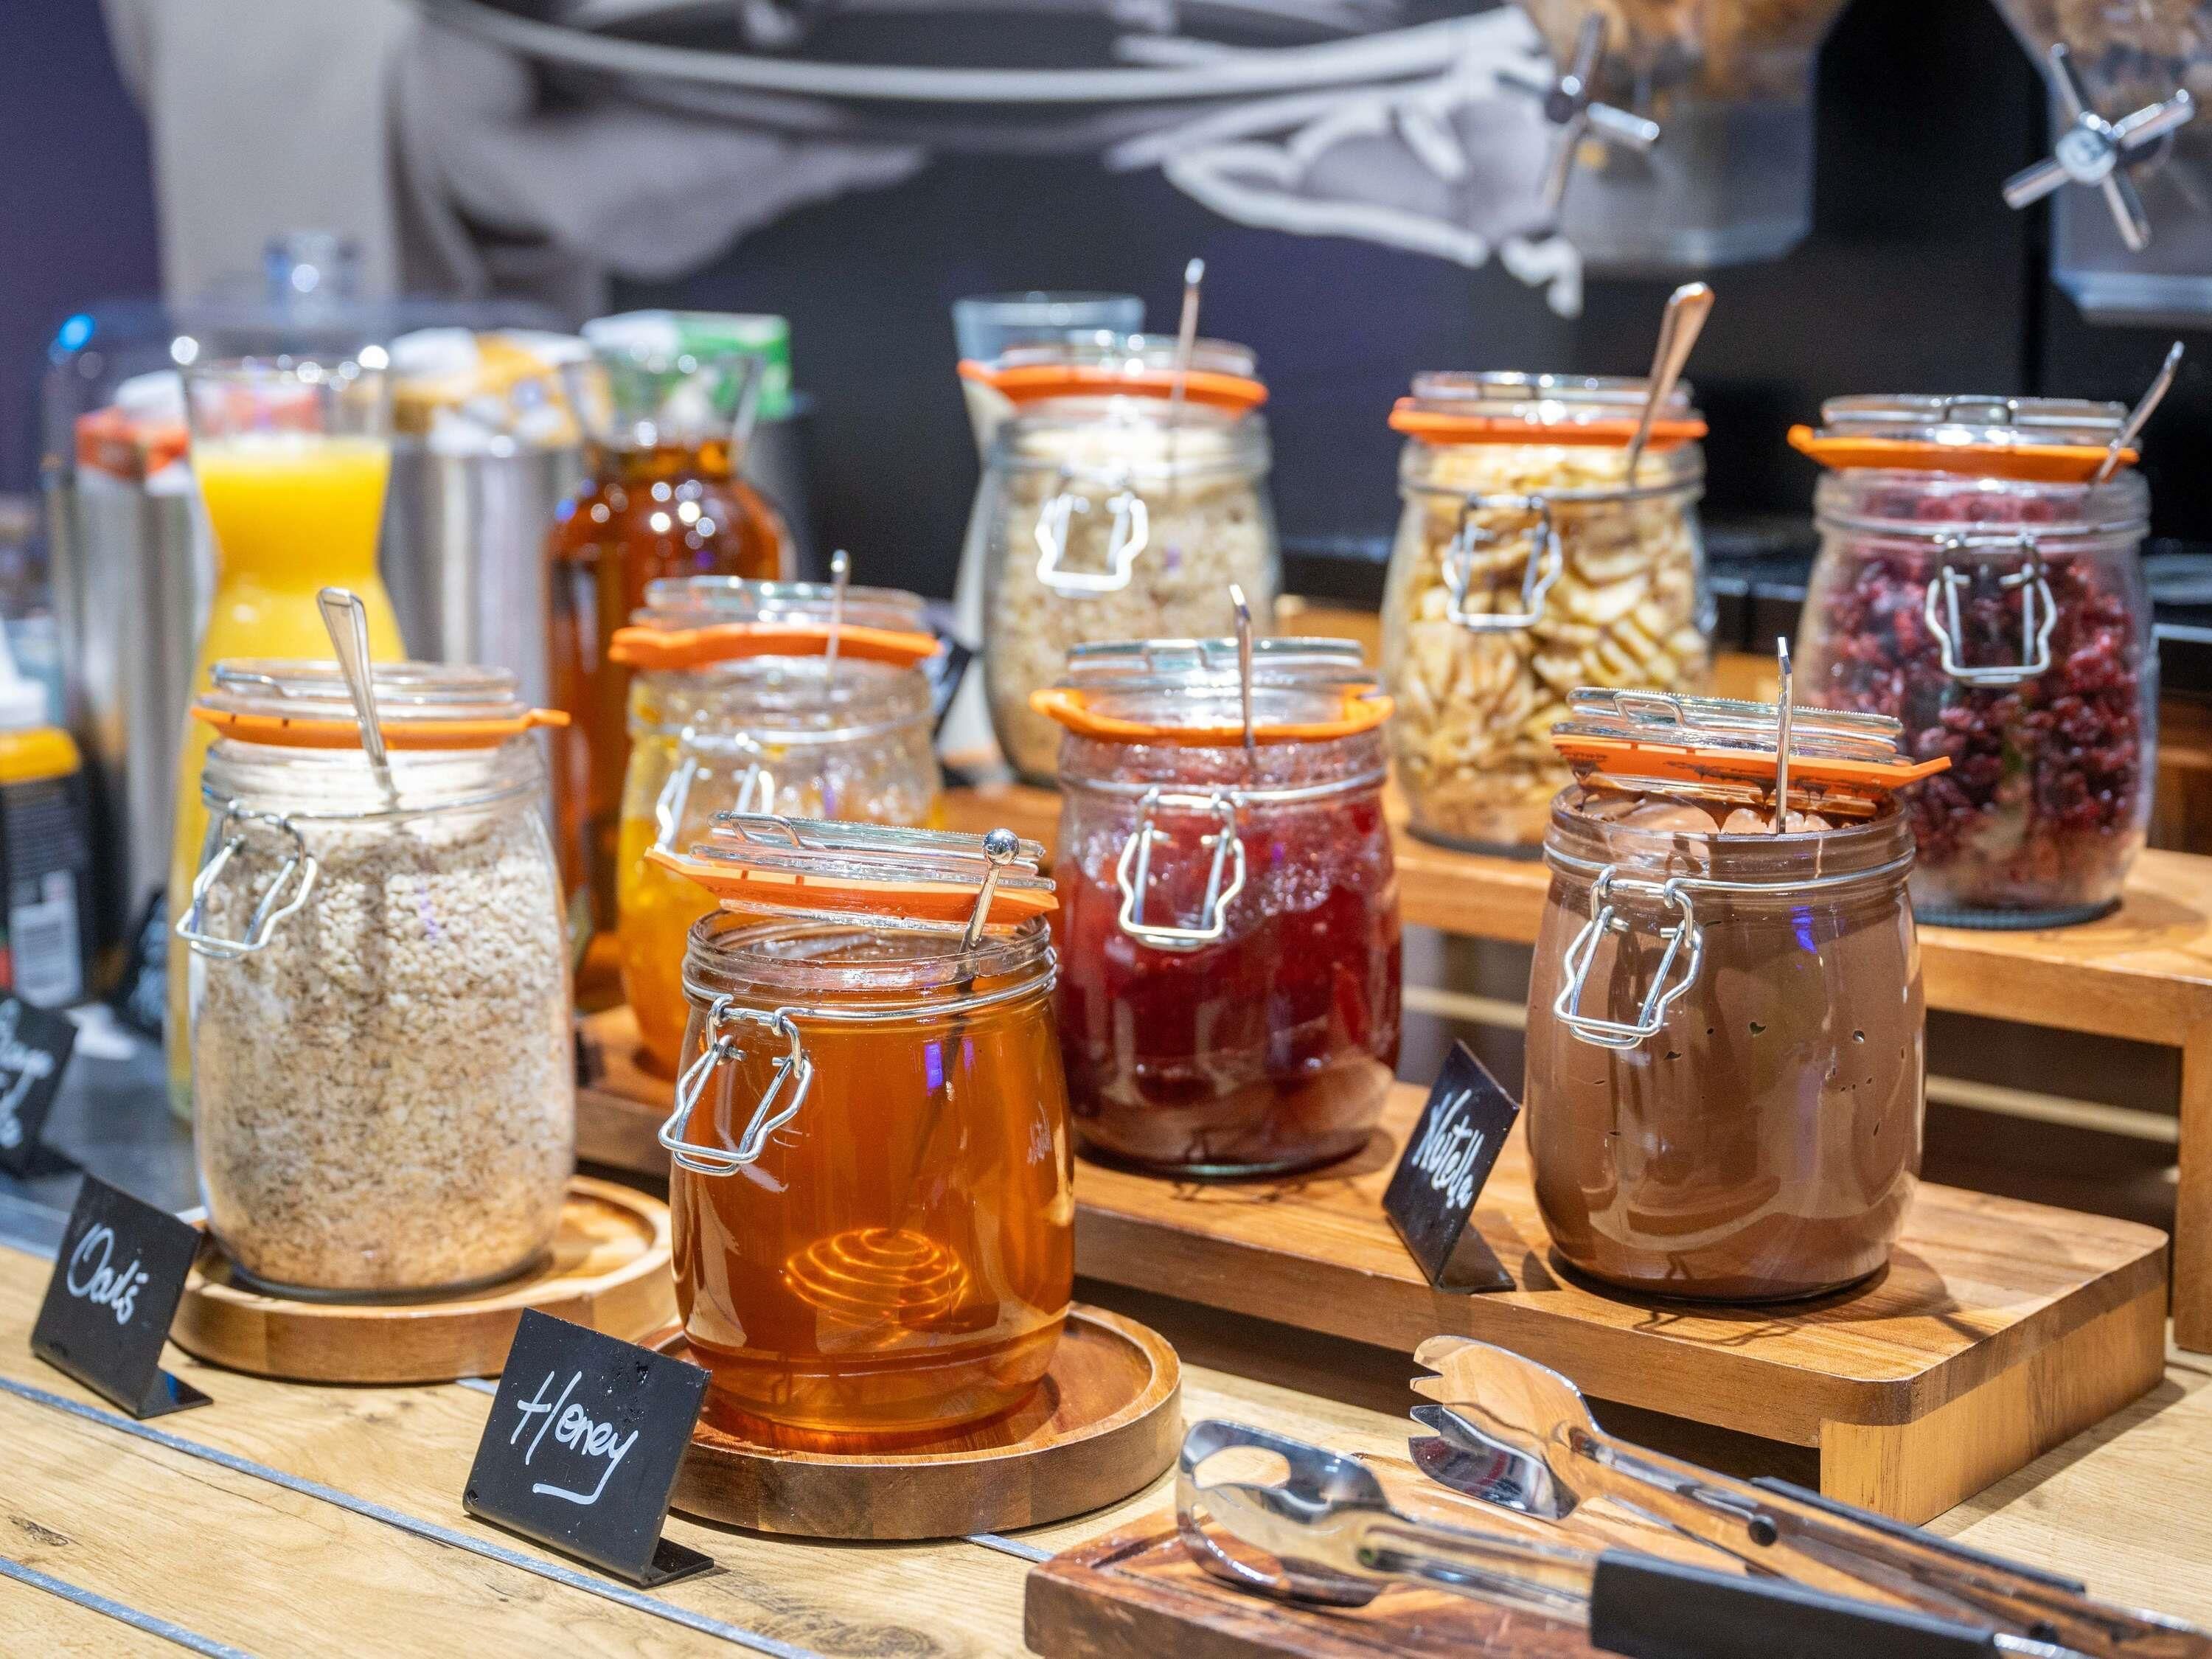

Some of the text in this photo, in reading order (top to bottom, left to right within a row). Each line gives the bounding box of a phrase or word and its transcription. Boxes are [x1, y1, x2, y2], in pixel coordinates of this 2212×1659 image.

[1411, 1089, 1484, 1209] Nutella
[67, 1222, 149, 1325] Oats
[510, 1371, 639, 1505] Honey
